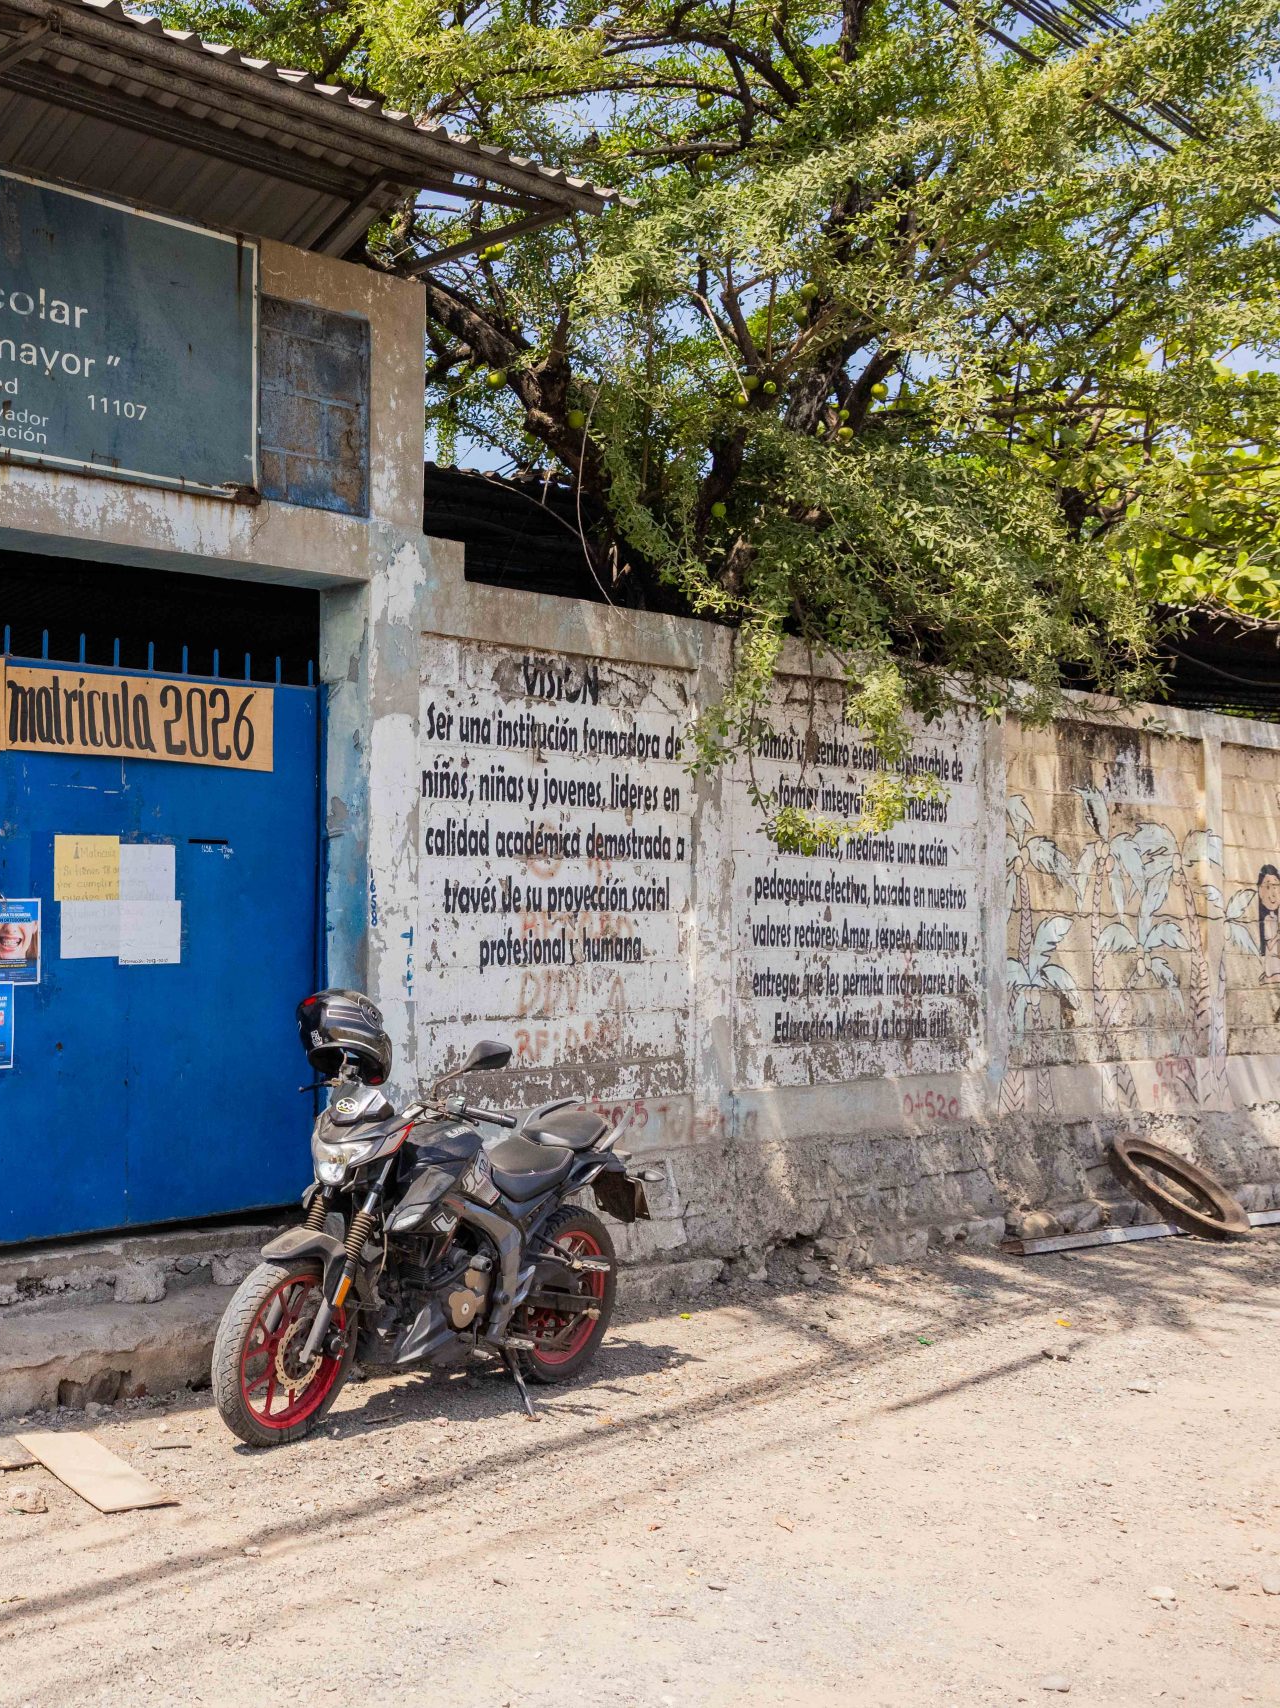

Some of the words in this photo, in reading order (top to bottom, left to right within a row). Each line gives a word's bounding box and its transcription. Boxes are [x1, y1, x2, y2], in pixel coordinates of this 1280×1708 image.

[87, 394, 148, 421] 11107
[7, 674, 157, 754] matrícula
[160, 684, 256, 762] 2026
[426, 701, 454, 741] Ser
[459, 715, 492, 745] una
[496, 708, 578, 753] institución
[583, 716, 661, 760] formadora
[664, 725, 682, 761] de
[479, 764, 524, 803] niñas
[527, 777, 539, 812] y
[610, 772, 658, 812] lideres
[663, 785, 680, 812] en
[951, 751, 963, 783] de
[778, 773, 819, 810] formar
[425, 817, 490, 857] calidad
[495, 820, 581, 859] académica
[586, 822, 671, 861] demostrada
[677, 836, 685, 862] a
[846, 831, 895, 864] mediante
[897, 842, 916, 865] una
[919, 836, 948, 868] acción
[443, 875, 497, 914] través
[501, 874, 522, 914] de
[526, 884, 543, 913] su
[547, 876, 628, 921] proyección
[632, 876, 670, 912] social
[754, 867, 822, 907] pedagogica
[873, 874, 911, 908] basada
[913, 885, 926, 909] en
[928, 882, 967, 910] nuestros
[479, 926, 566, 975] profesional
[583, 926, 642, 963] humana
[752, 914, 792, 948] valores
[916, 920, 960, 957] disciplina
[961, 931, 969, 958] y
[826, 963, 840, 996] les
[842, 965, 884, 1003] permita
[948, 973, 955, 996] a
